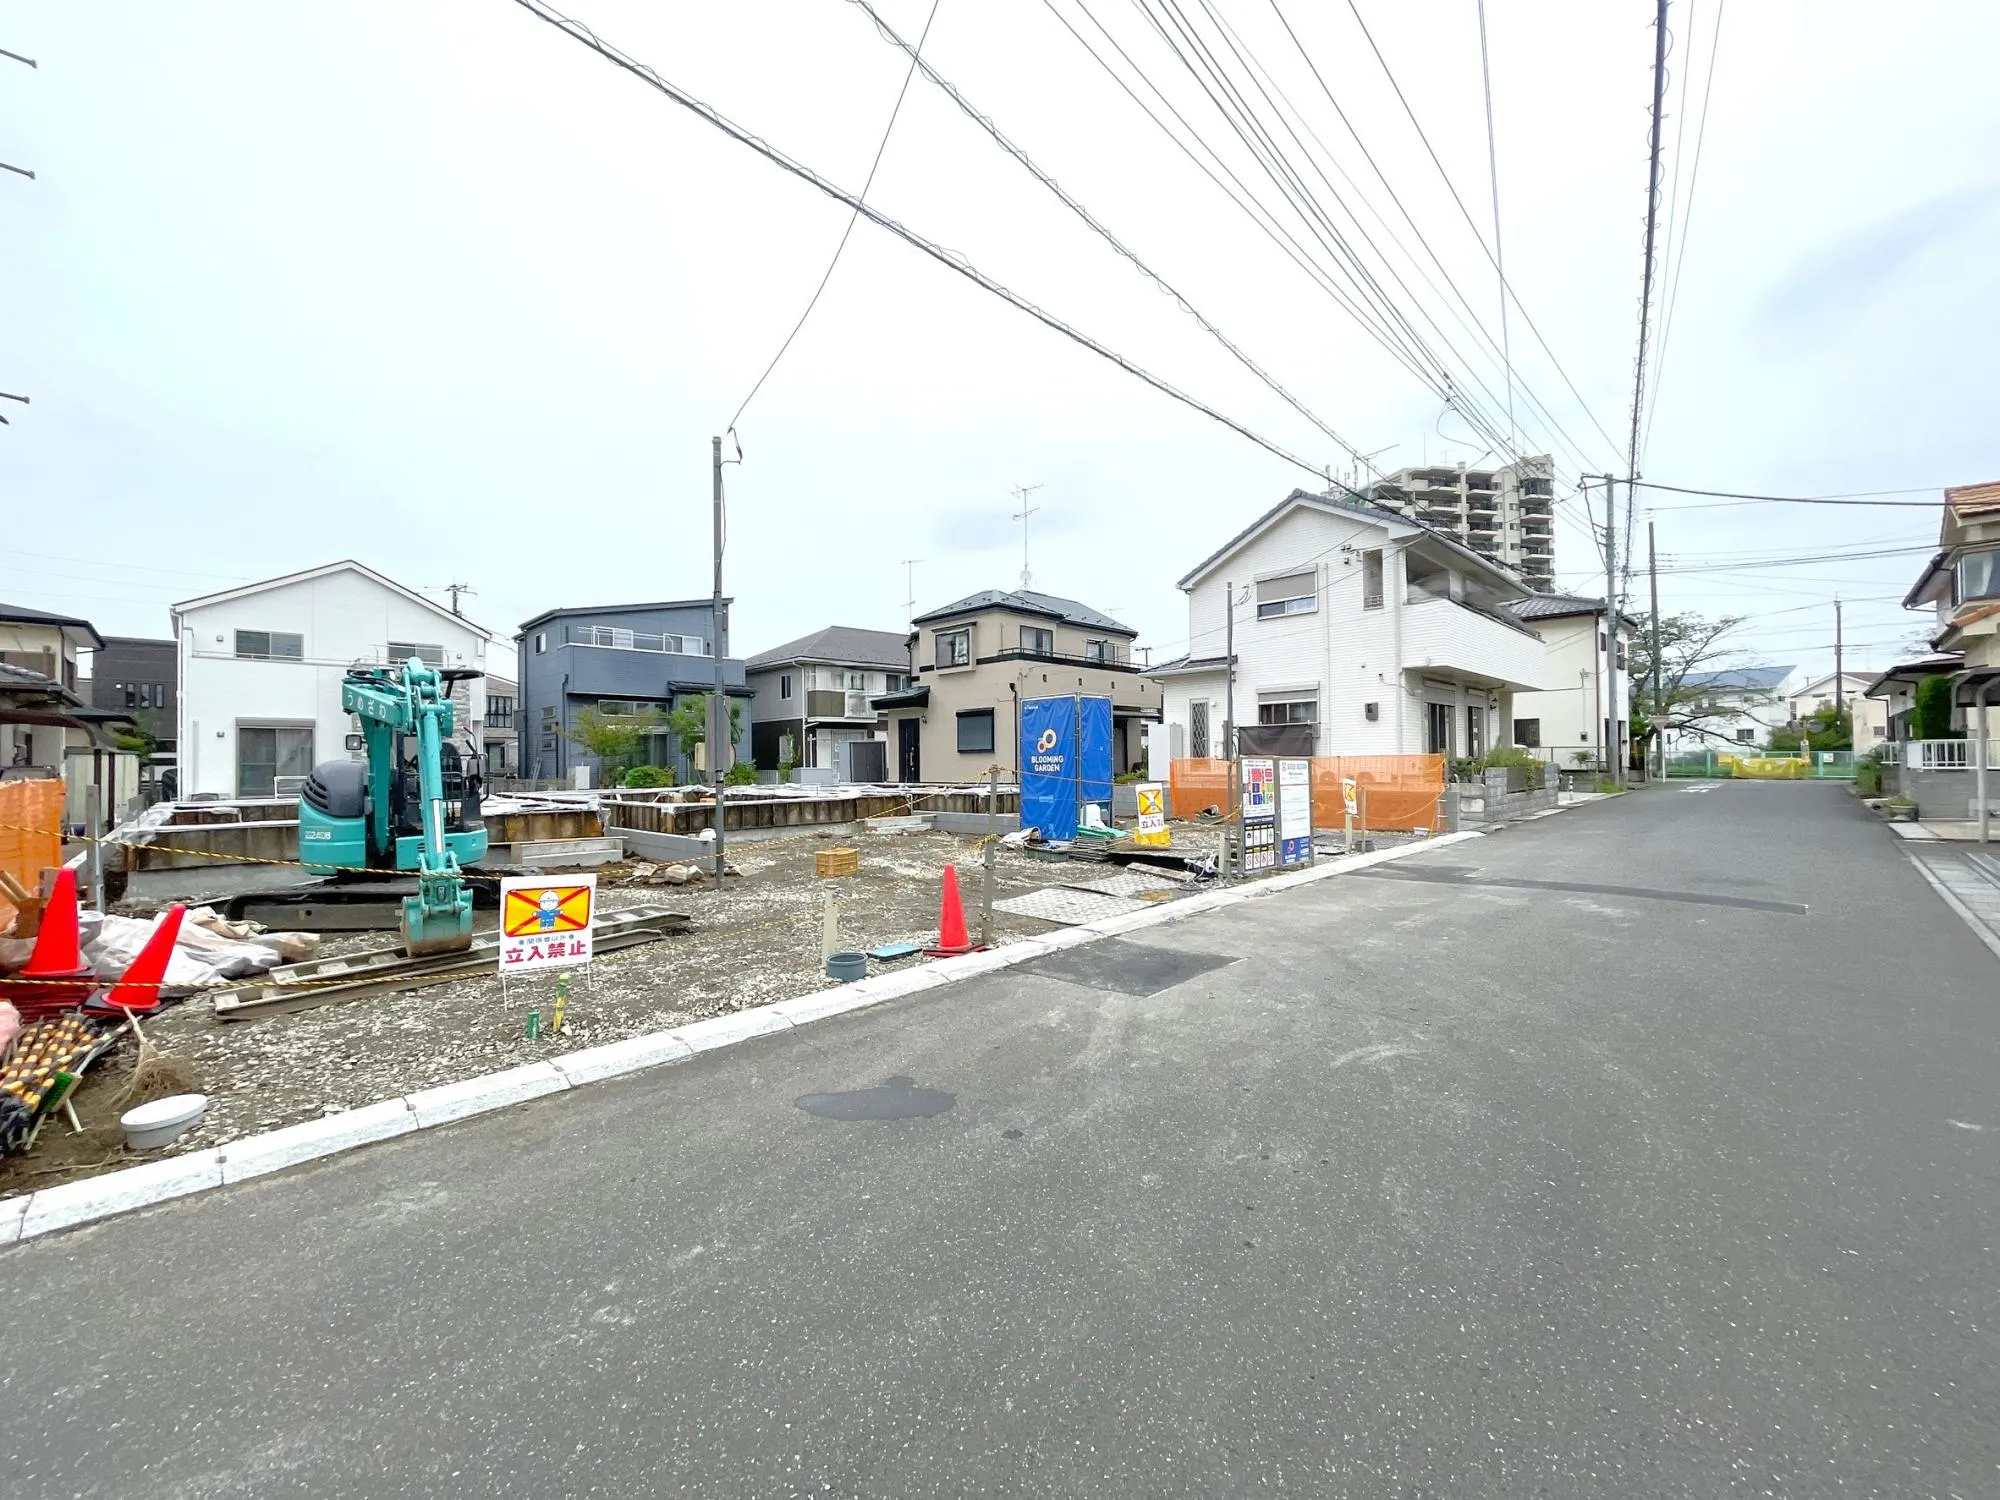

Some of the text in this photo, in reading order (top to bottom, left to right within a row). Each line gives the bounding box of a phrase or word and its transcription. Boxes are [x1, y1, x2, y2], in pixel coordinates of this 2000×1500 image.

[347, 691, 386, 719] うめざわ
[1031, 755, 1064, 764] BLOOMING
[1034, 763, 1061, 772] GARDEN
[505, 940, 587, 964] 立入禁止
